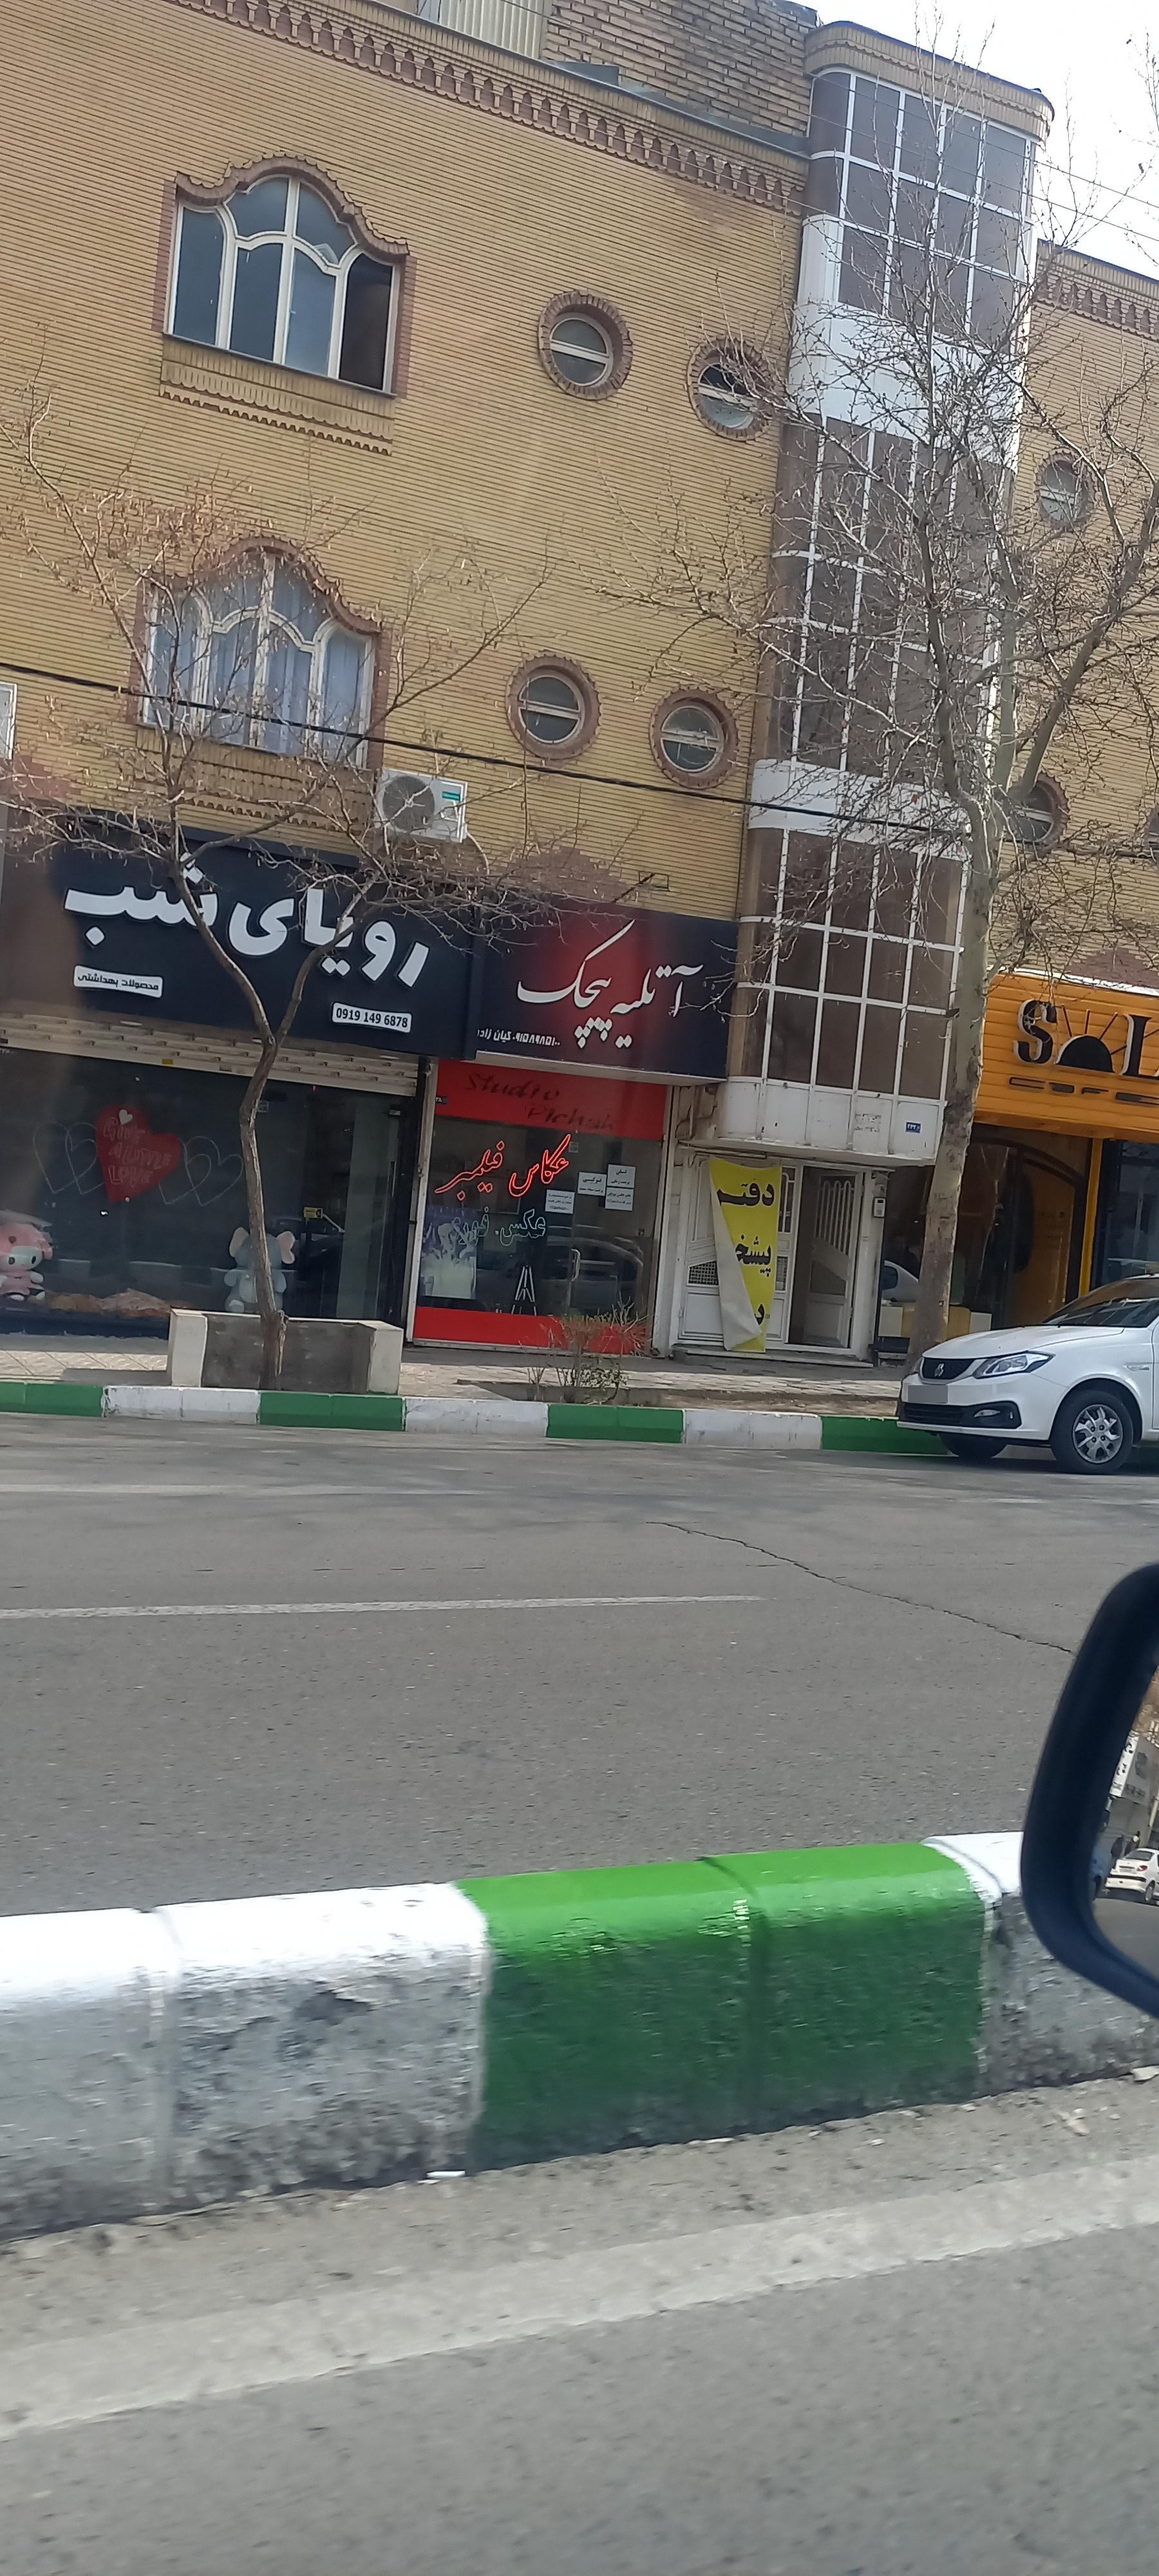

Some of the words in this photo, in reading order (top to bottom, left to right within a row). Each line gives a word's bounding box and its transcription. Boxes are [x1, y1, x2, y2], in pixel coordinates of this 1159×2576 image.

[64, 852, 220, 948] شب
[228, 887, 430, 988] رویای
[336, 1007, 361, 1021] 0919
[363, 1012, 381, 1024] 149
[384, 1014, 408, 1028] 6878
[517, 918, 636, 1048] پیچک
[610, 963, 704, 1048] آتلیه
[509, 1133, 572, 1198] عکاس
